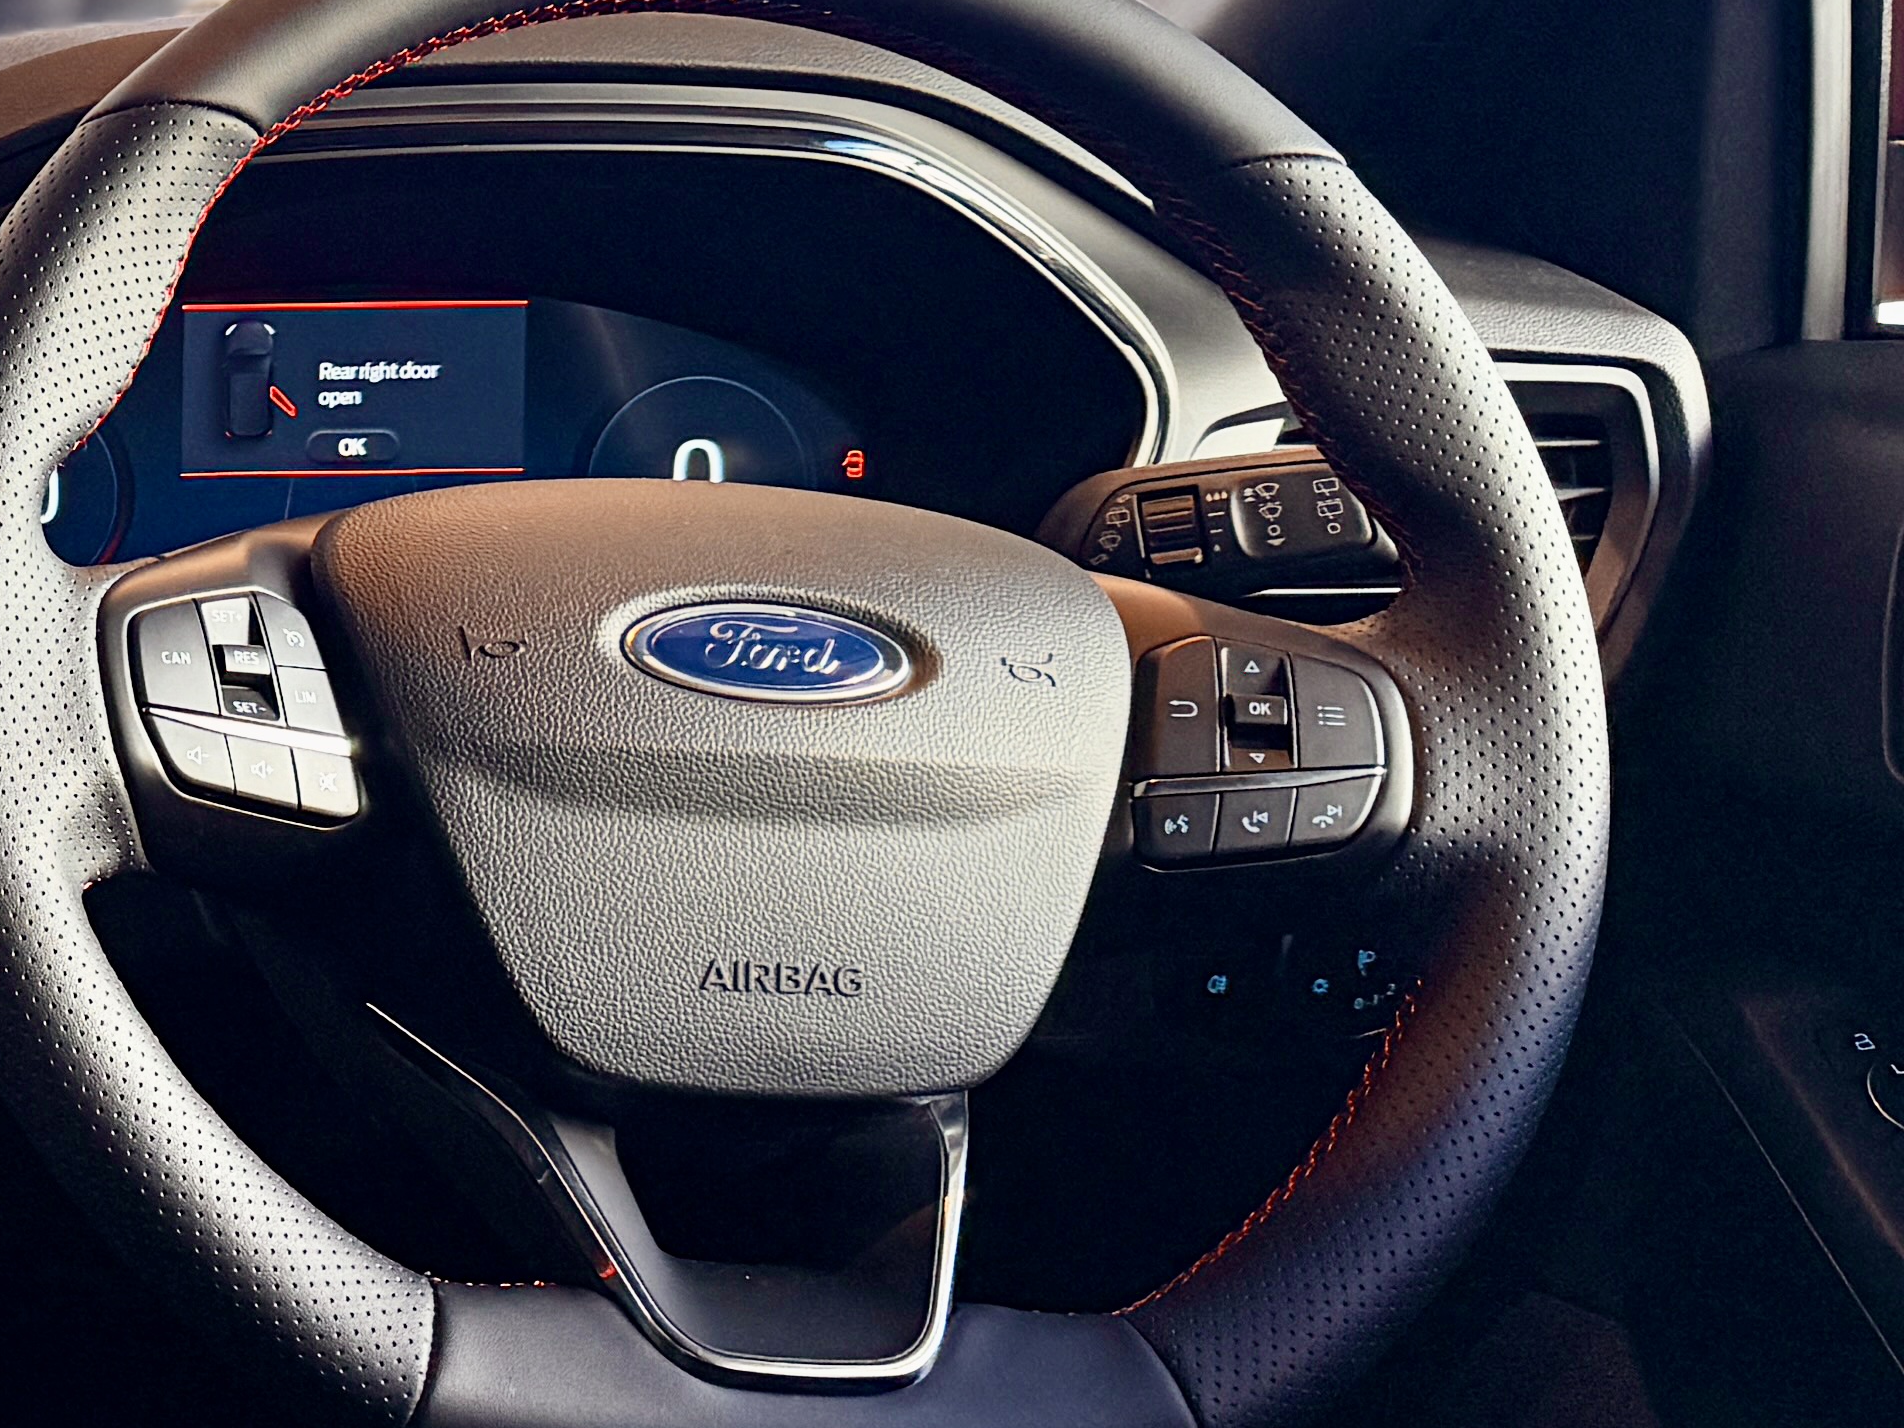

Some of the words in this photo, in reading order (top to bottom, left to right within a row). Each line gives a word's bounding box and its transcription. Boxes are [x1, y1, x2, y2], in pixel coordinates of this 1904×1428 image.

[318, 361, 359, 380] Rear
[359, 360, 399, 383] right
[399, 360, 442, 379] door
[318, 390, 363, 408] open
[338, 437, 368, 457] OK
[704, 619, 842, 675] Ford
[161, 651, 192, 665] CAN
[234, 651, 260, 665] RES
[294, 690, 317, 704] LIM
[1248, 701, 1272, 716] OK
[699, 958, 864, 997] AIRBAG
